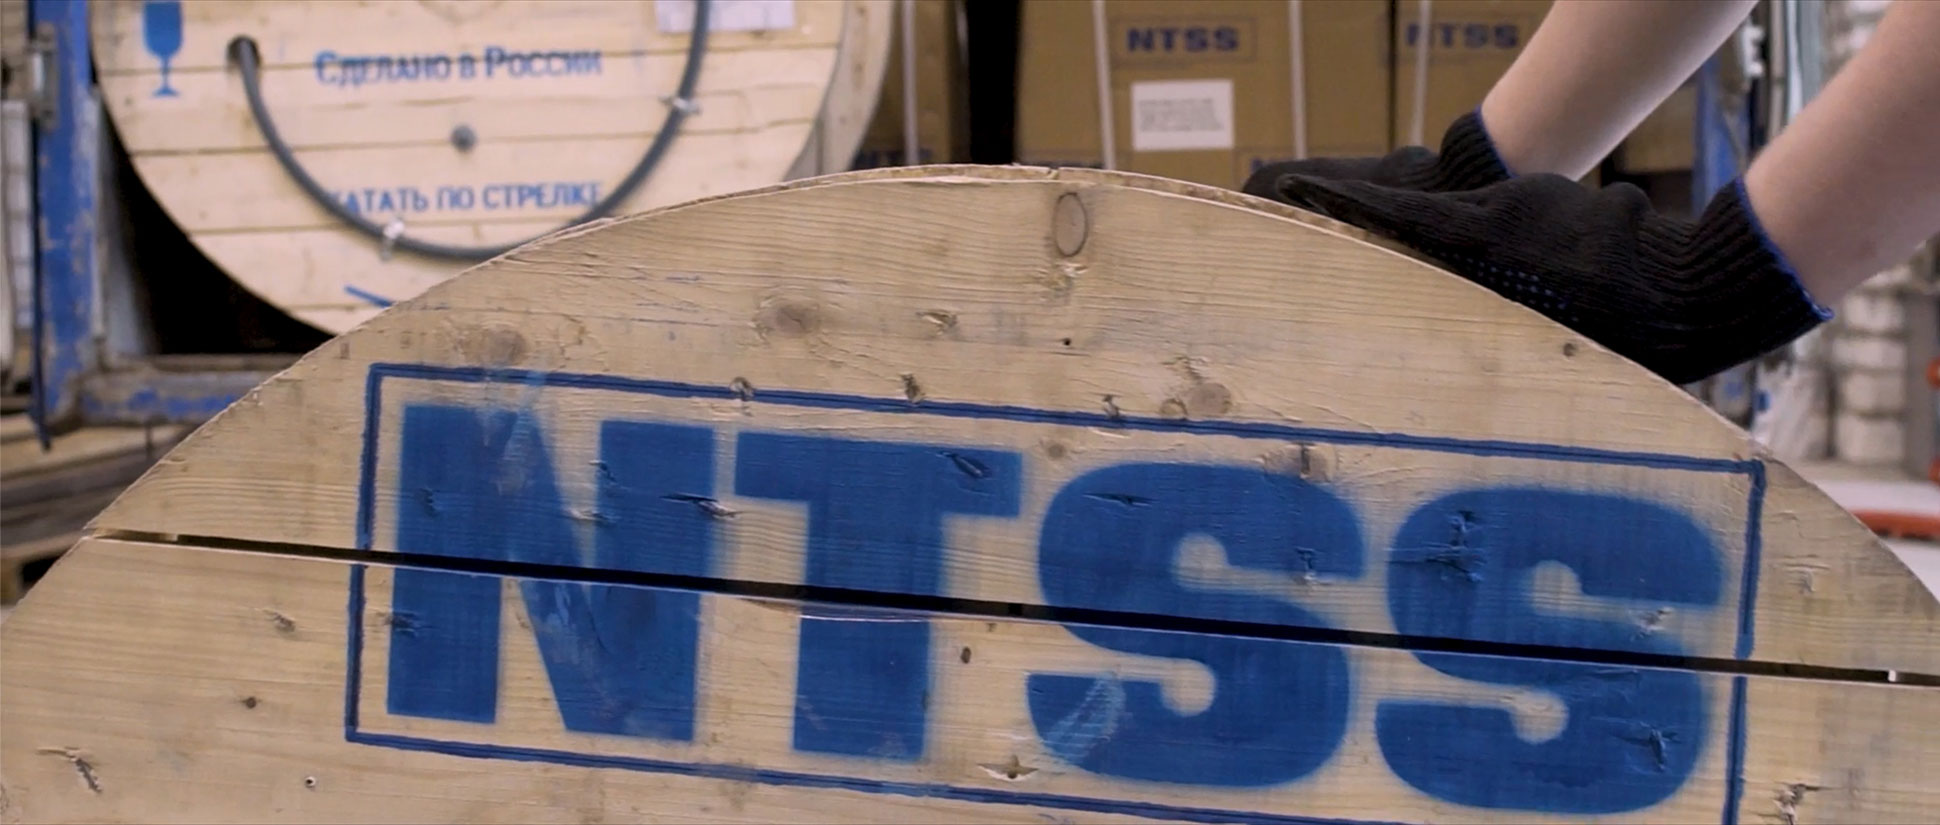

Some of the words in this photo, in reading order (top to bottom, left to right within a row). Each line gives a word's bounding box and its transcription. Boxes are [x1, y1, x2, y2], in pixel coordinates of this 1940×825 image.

[1128, 27, 1239, 51] NTSS
[436, 185, 475, 210] ПО
[388, 402, 1724, 814] NTSS
